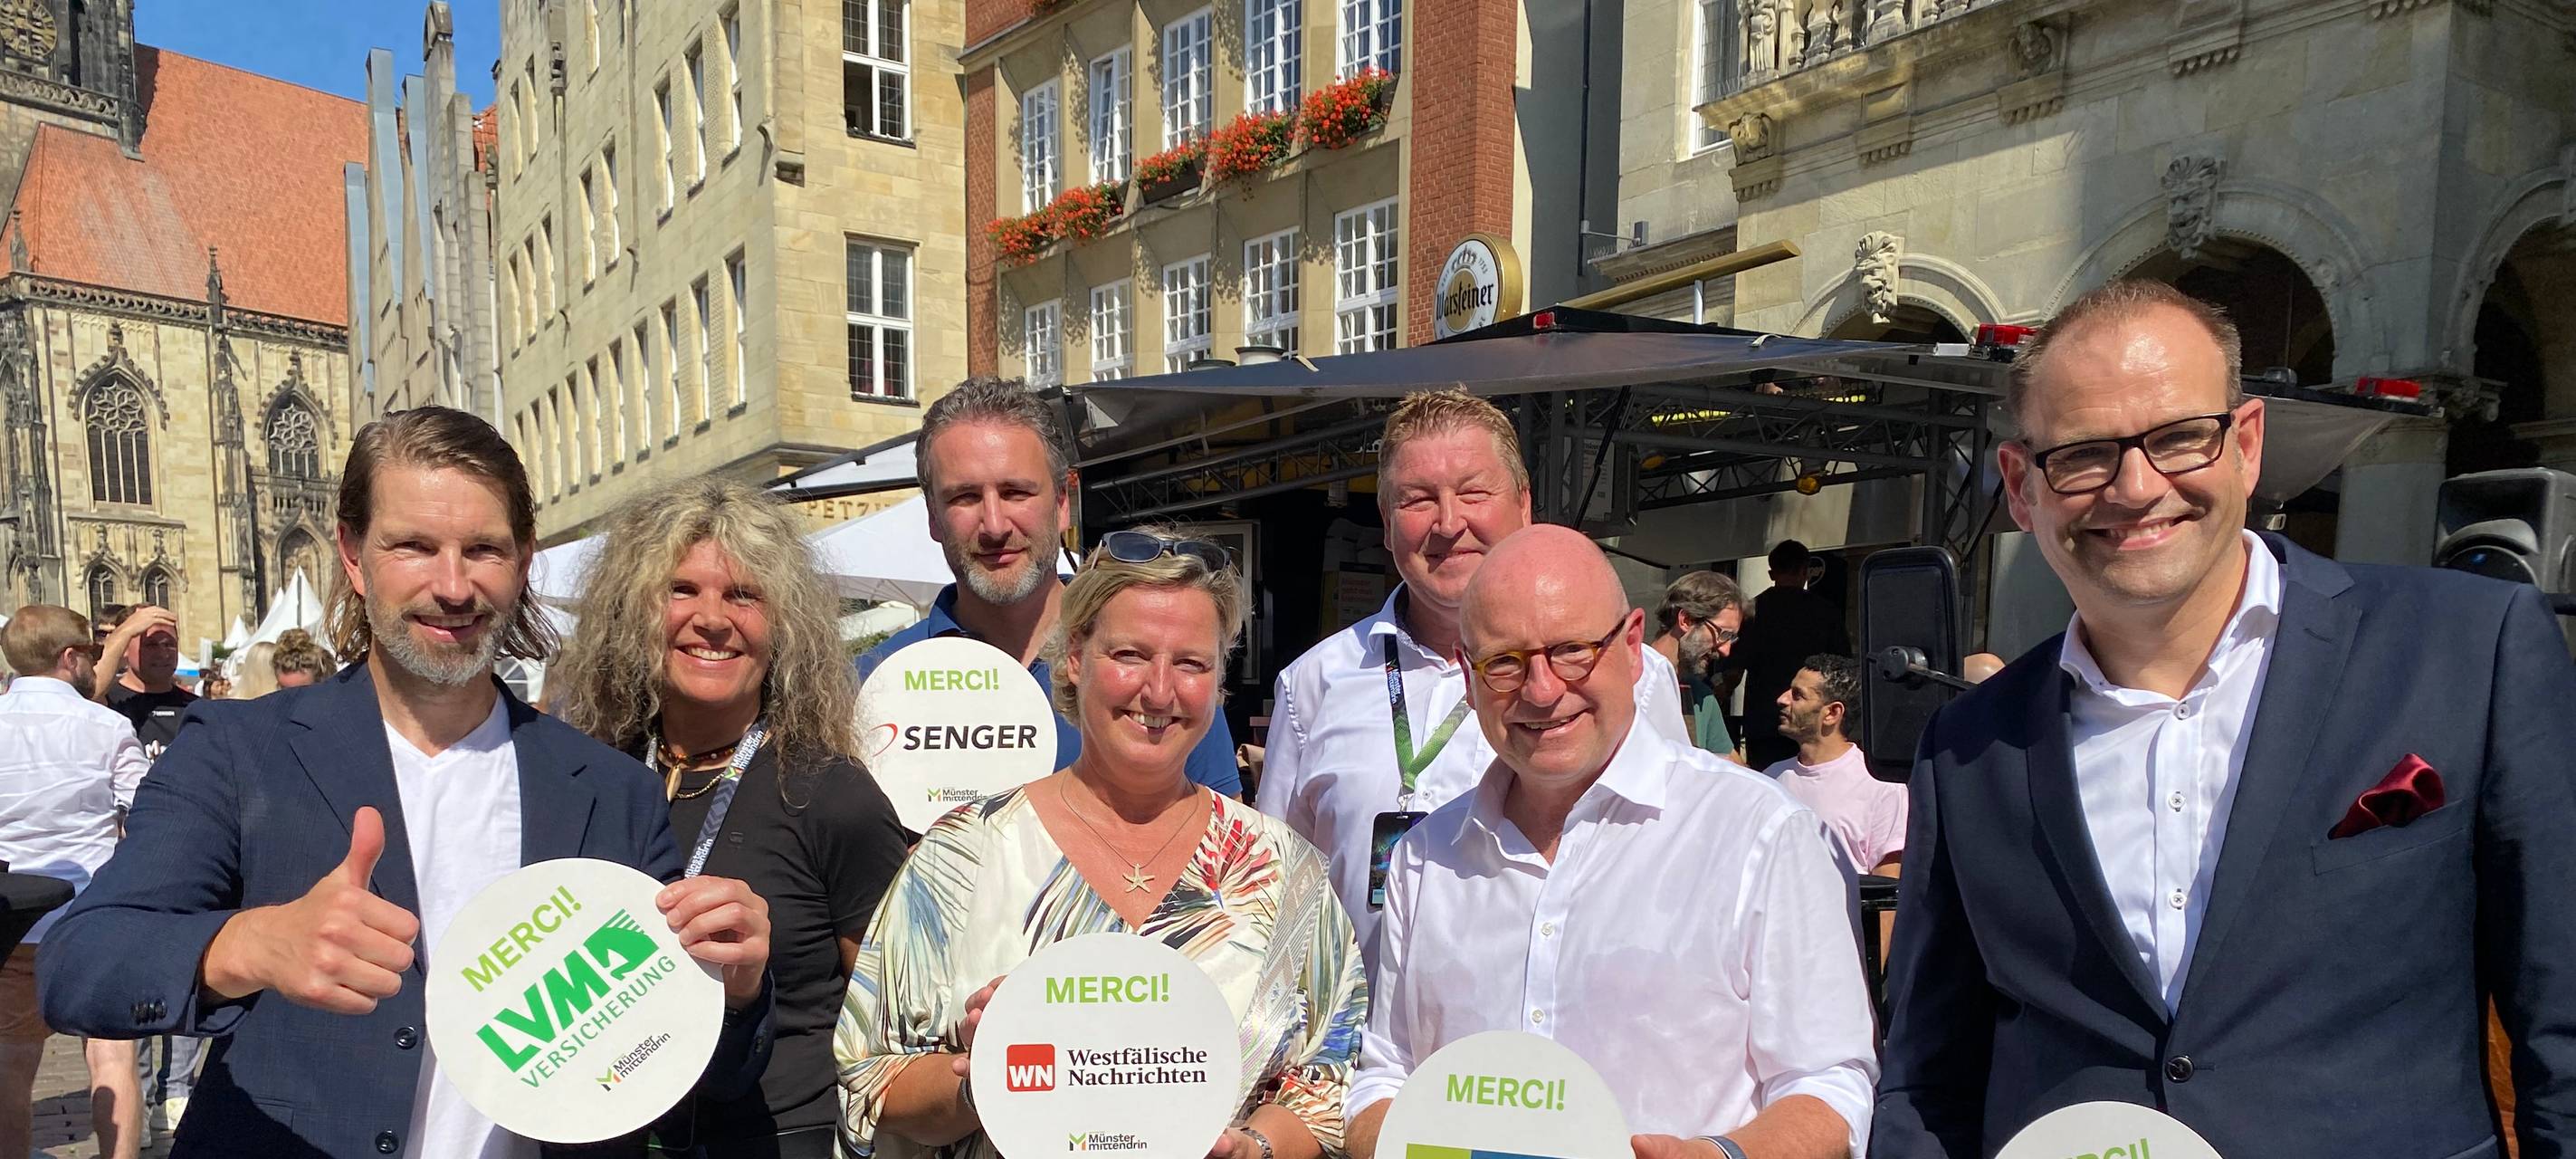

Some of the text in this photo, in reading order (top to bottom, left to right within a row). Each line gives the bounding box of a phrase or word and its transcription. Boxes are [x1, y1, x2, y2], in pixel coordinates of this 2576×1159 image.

[1436, 282, 1494, 321] Warsteiner
[905, 668, 1000, 691] MERCI!
[903, 724, 1038, 751] SENGER
[942, 788, 978, 796] Münster
[942, 794, 987, 802] mittendri
[461, 885, 582, 992] MERCI!
[1045, 973, 1169, 1004] MERCI!
[475, 949, 612, 1073] LVM
[520, 955, 676, 1088] VERSICHERUNG
[613, 1035, 653, 1072] Münster
[619, 1032, 671, 1078] mittendrin
[1067, 1047, 1207, 1066] Westfälische
[1008, 1065, 1053, 1087] WN
[1068, 1067, 1207, 1086] Nachrichten
[1446, 1074, 1566, 1111] MERCI!
[1089, 1134, 1135, 1143] Münster
[1089, 1140, 1148, 1151] mittendrin
